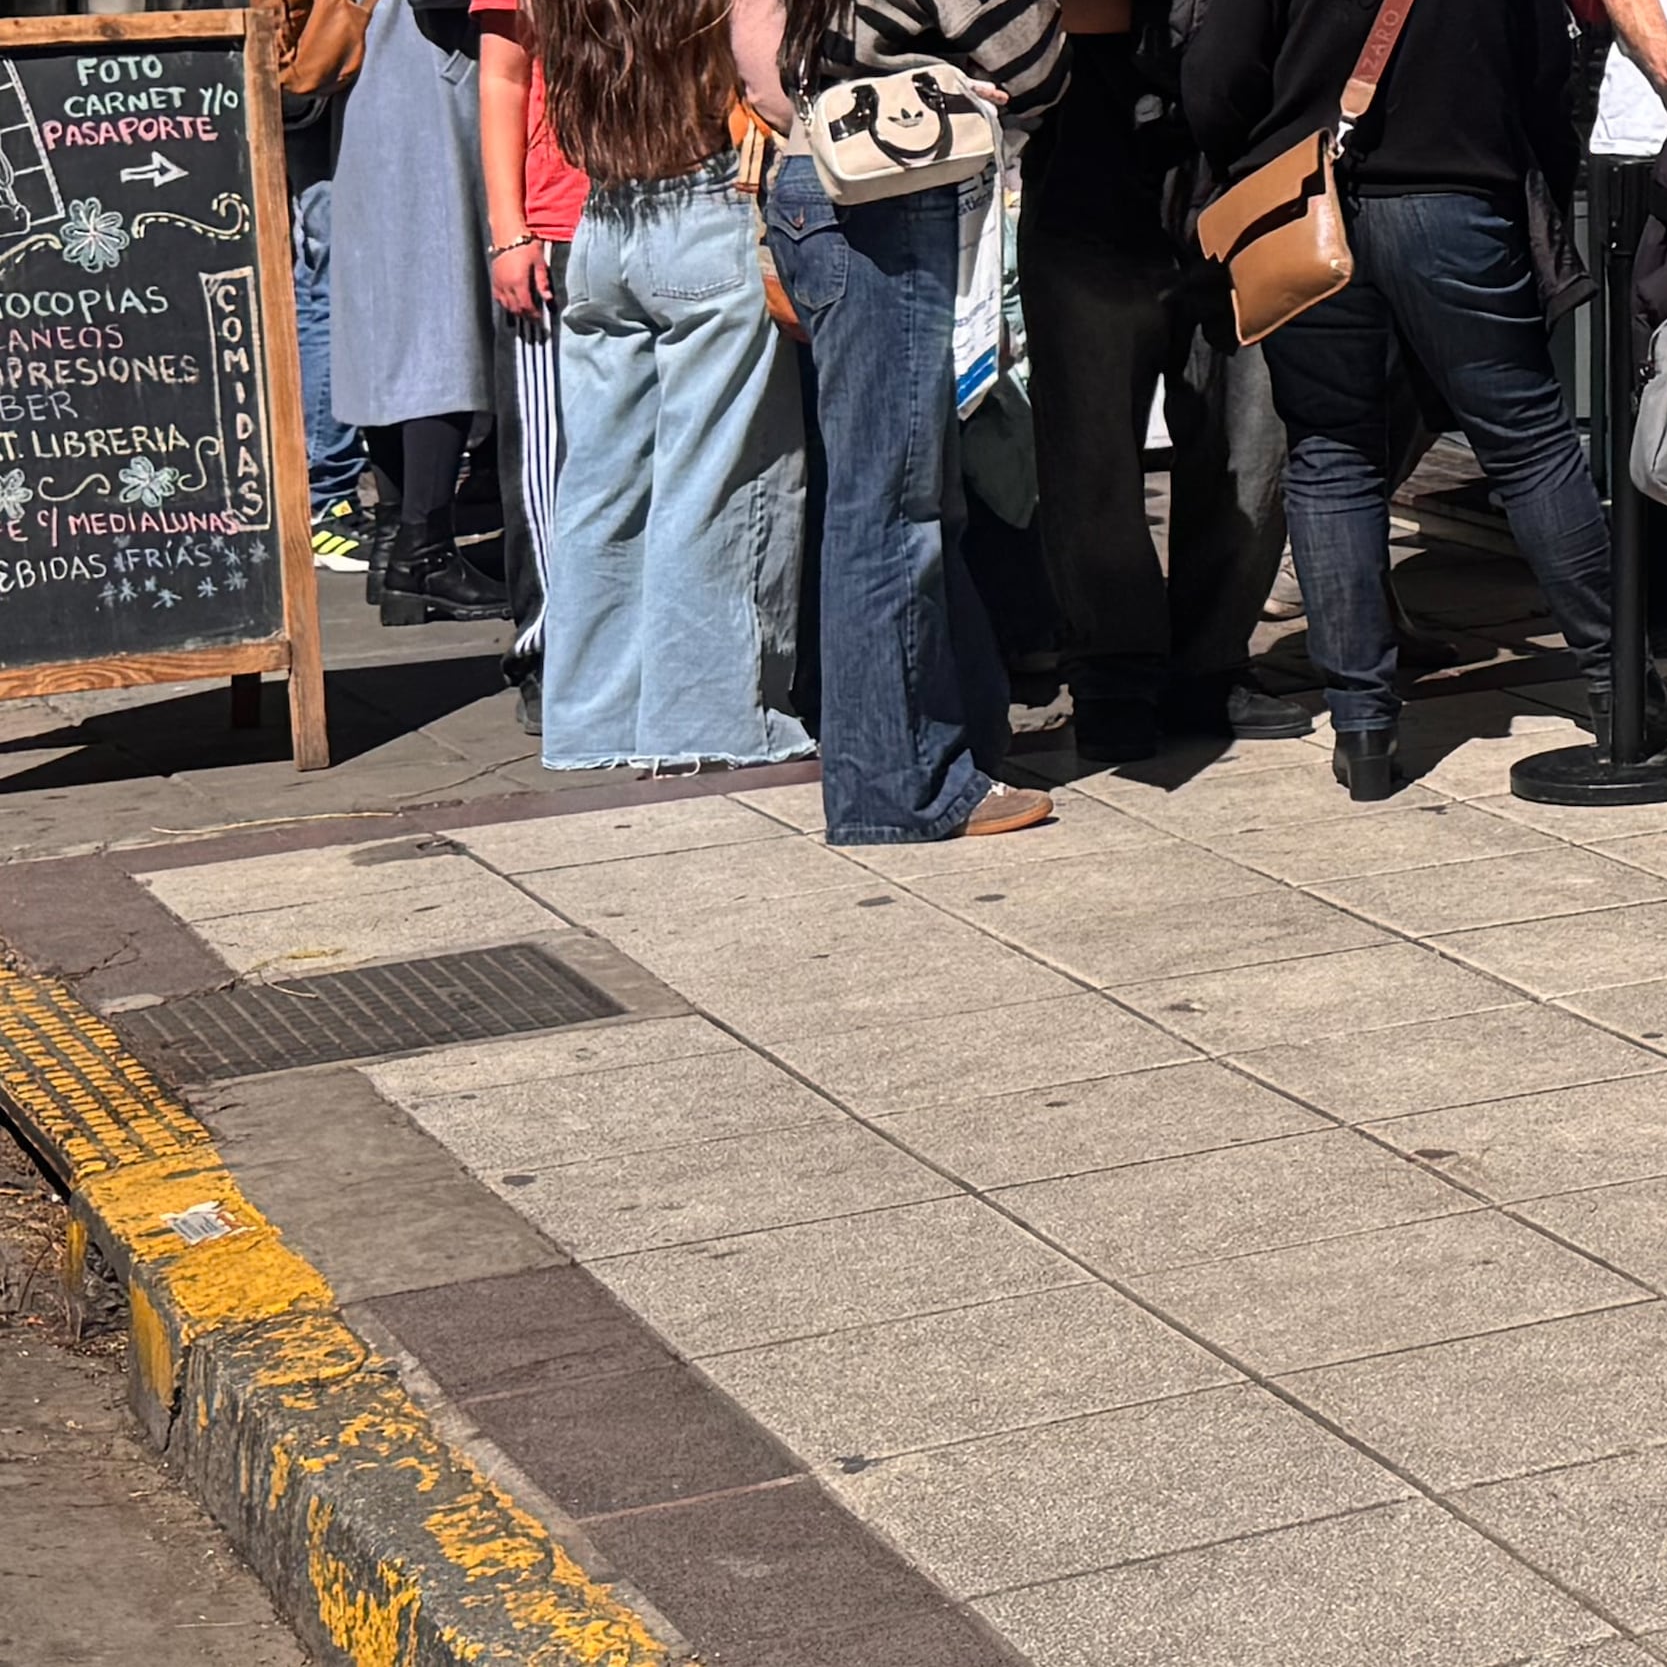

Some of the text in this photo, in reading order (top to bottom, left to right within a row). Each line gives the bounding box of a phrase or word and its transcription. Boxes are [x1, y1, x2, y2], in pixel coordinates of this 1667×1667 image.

[77, 55, 163, 87] FOTO
[64, 86, 186, 118] CARNET
[42, 115, 218, 150] PASAPORTE
[0, 323, 124, 354] ANEOS
[0, 354, 199, 389] PRESIONES
[216, 284, 264, 517] COMIDAS
[31, 423, 190, 459] LIBRERIA
[68, 508, 241, 537] MEDIALUNAS
